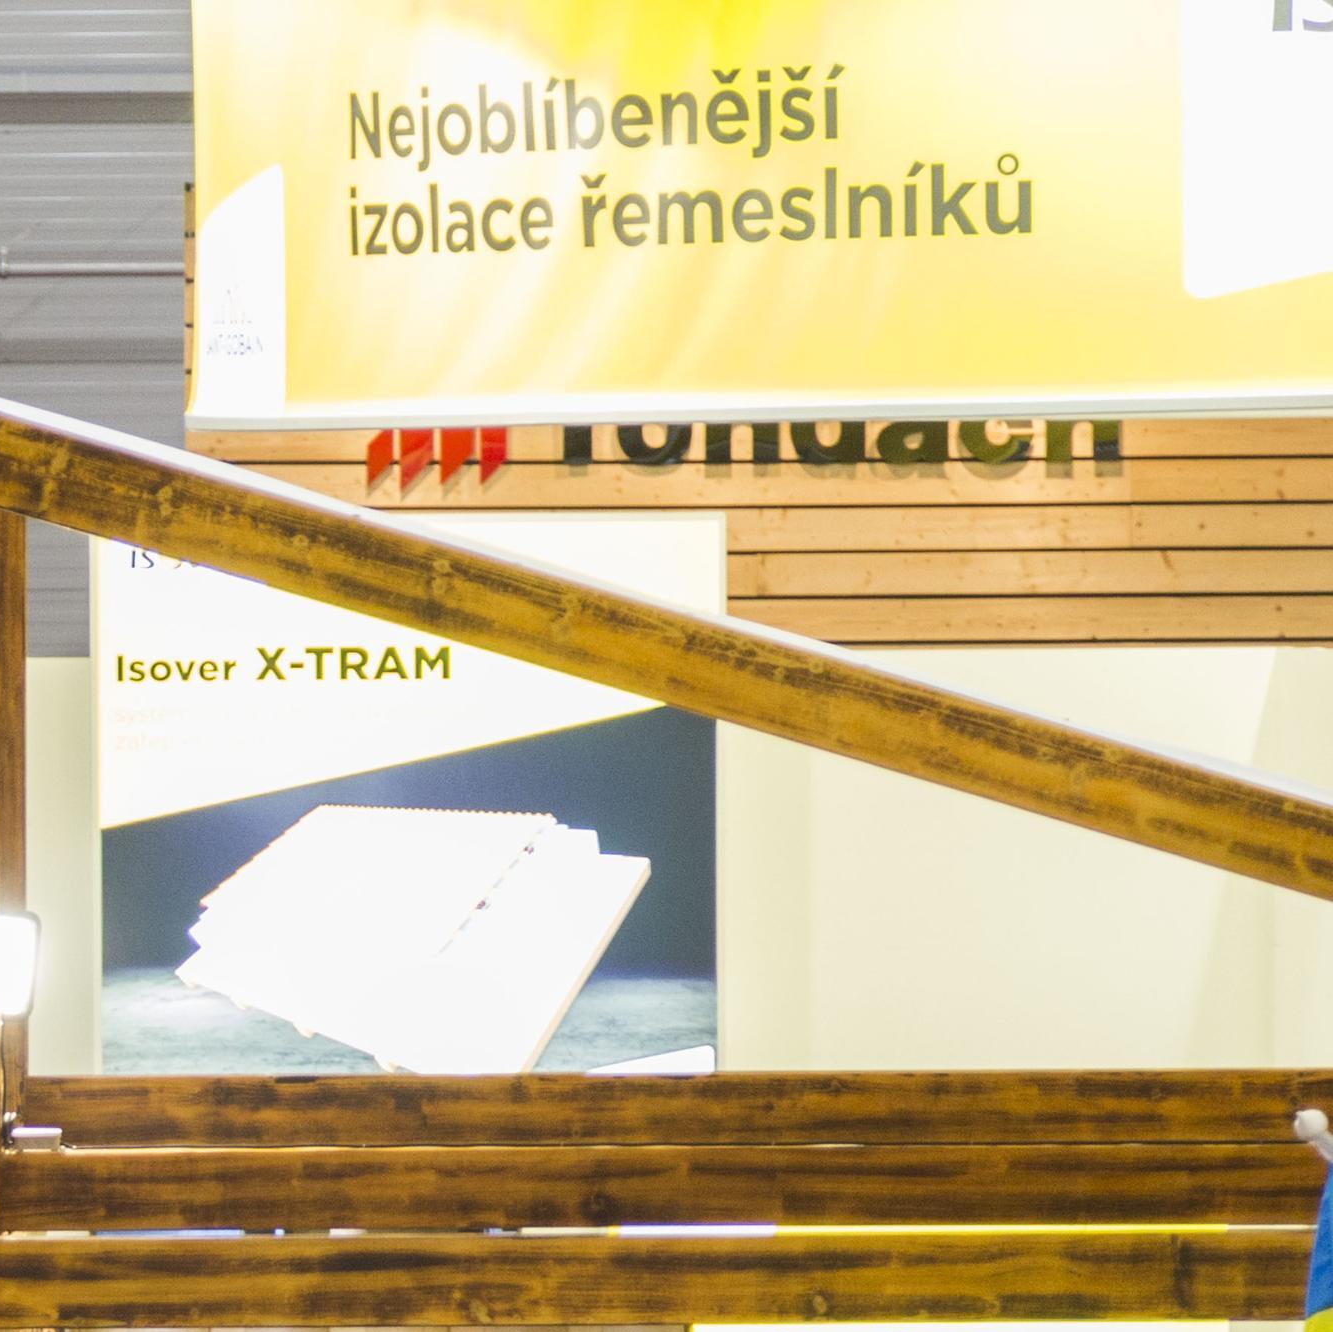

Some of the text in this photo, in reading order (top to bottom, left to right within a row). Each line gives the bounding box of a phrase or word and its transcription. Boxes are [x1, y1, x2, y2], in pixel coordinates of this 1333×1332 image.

[348, 64, 846, 172] Nejoblíbenější
[348, 153, 1032, 256] izolace řemeslníků
[116, 646, 452, 682] Isover X-TRAM
